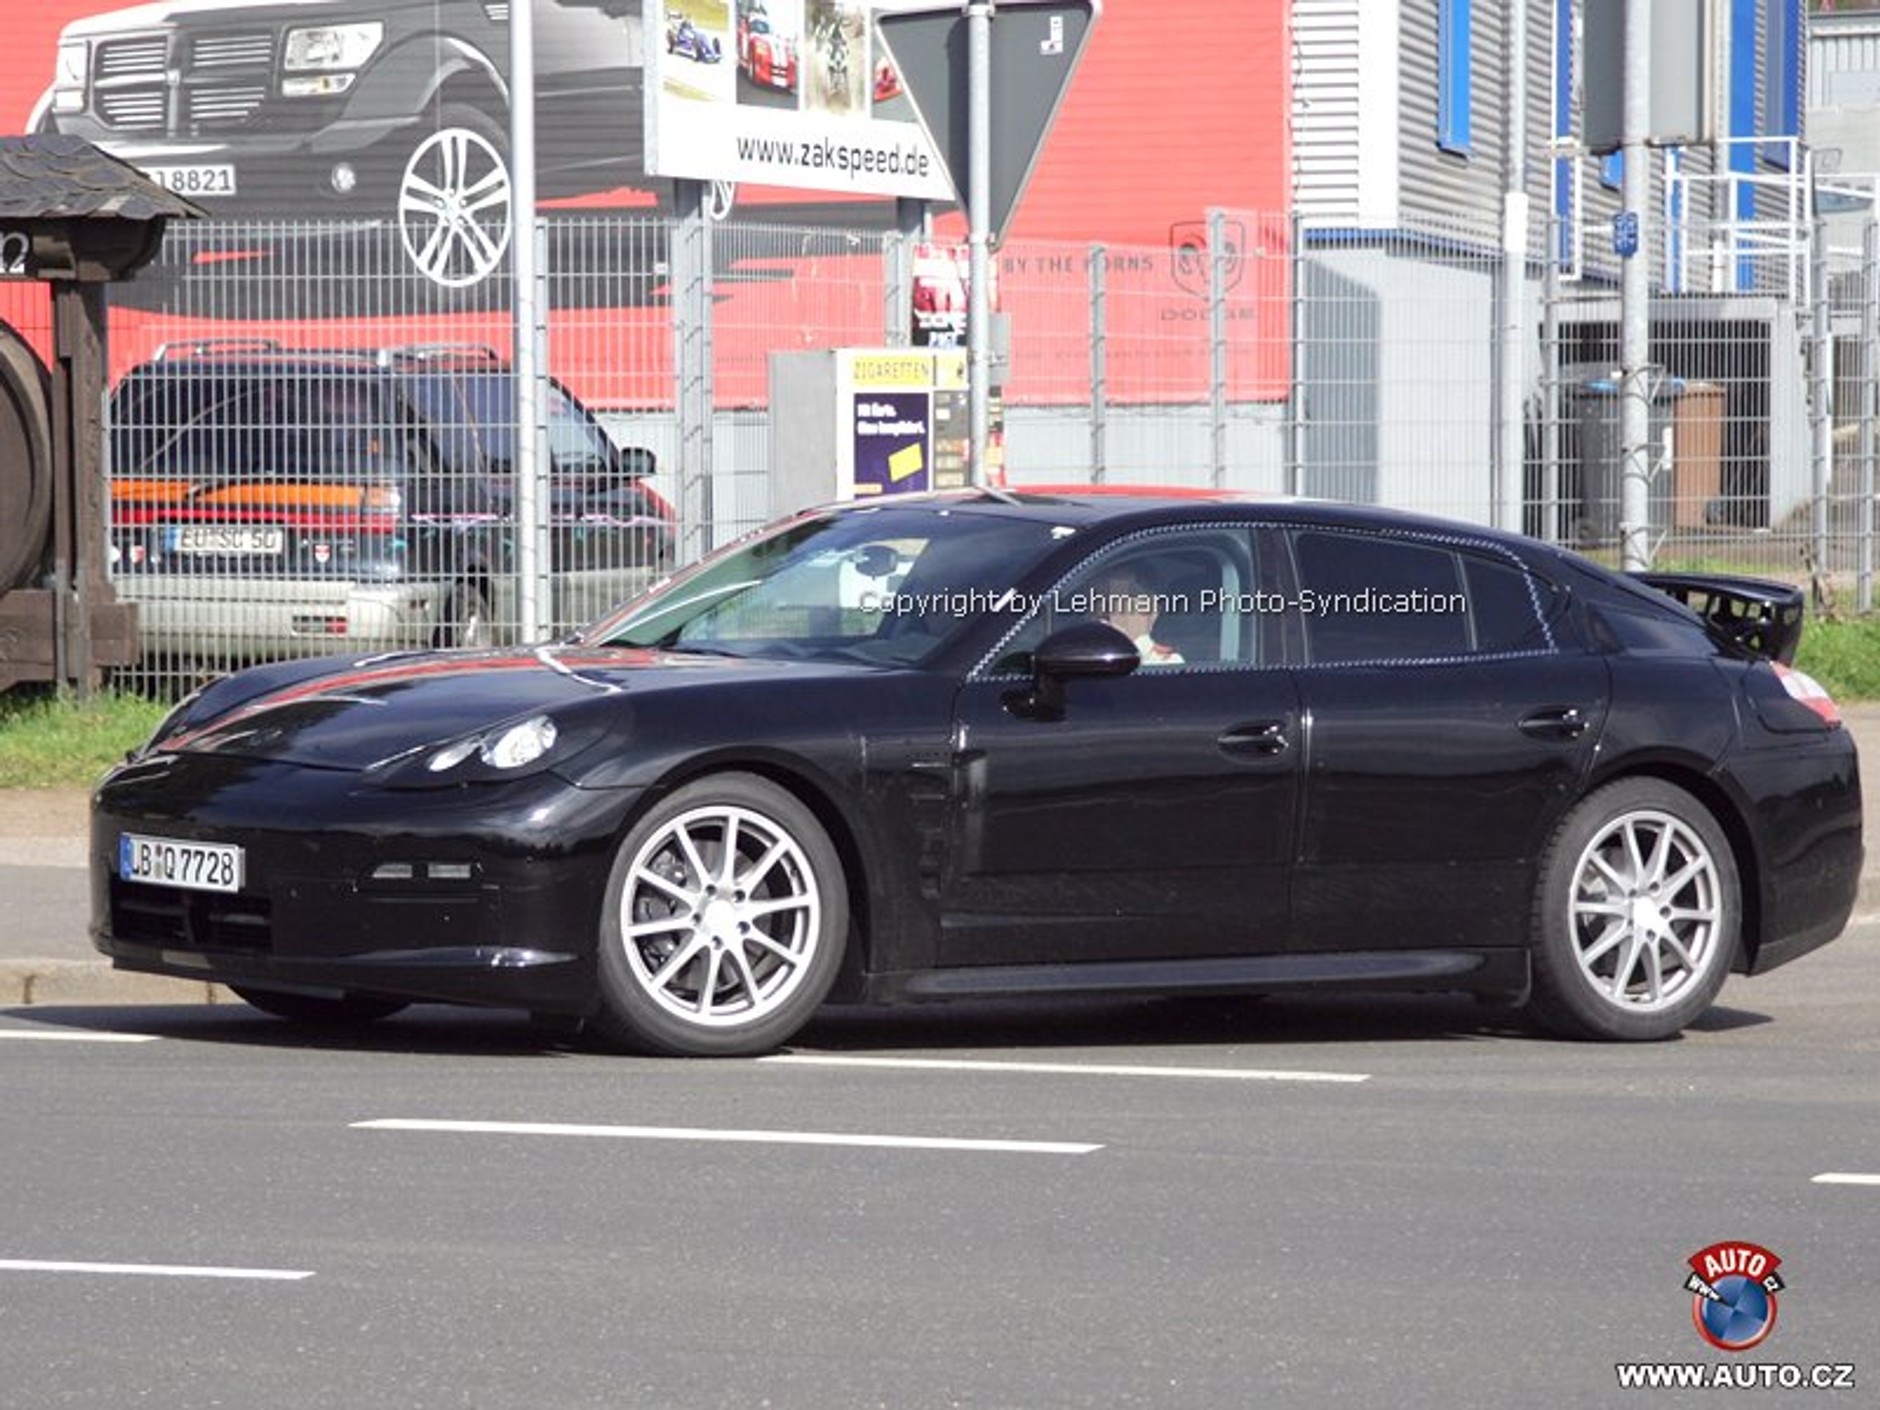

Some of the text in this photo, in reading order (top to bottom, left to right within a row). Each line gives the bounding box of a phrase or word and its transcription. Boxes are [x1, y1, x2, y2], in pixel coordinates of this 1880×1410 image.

[736, 136, 930, 180] www.zakspeed.de
[1085, 255, 1154, 275] ORNS
[180, 848, 234, 886] 7728
